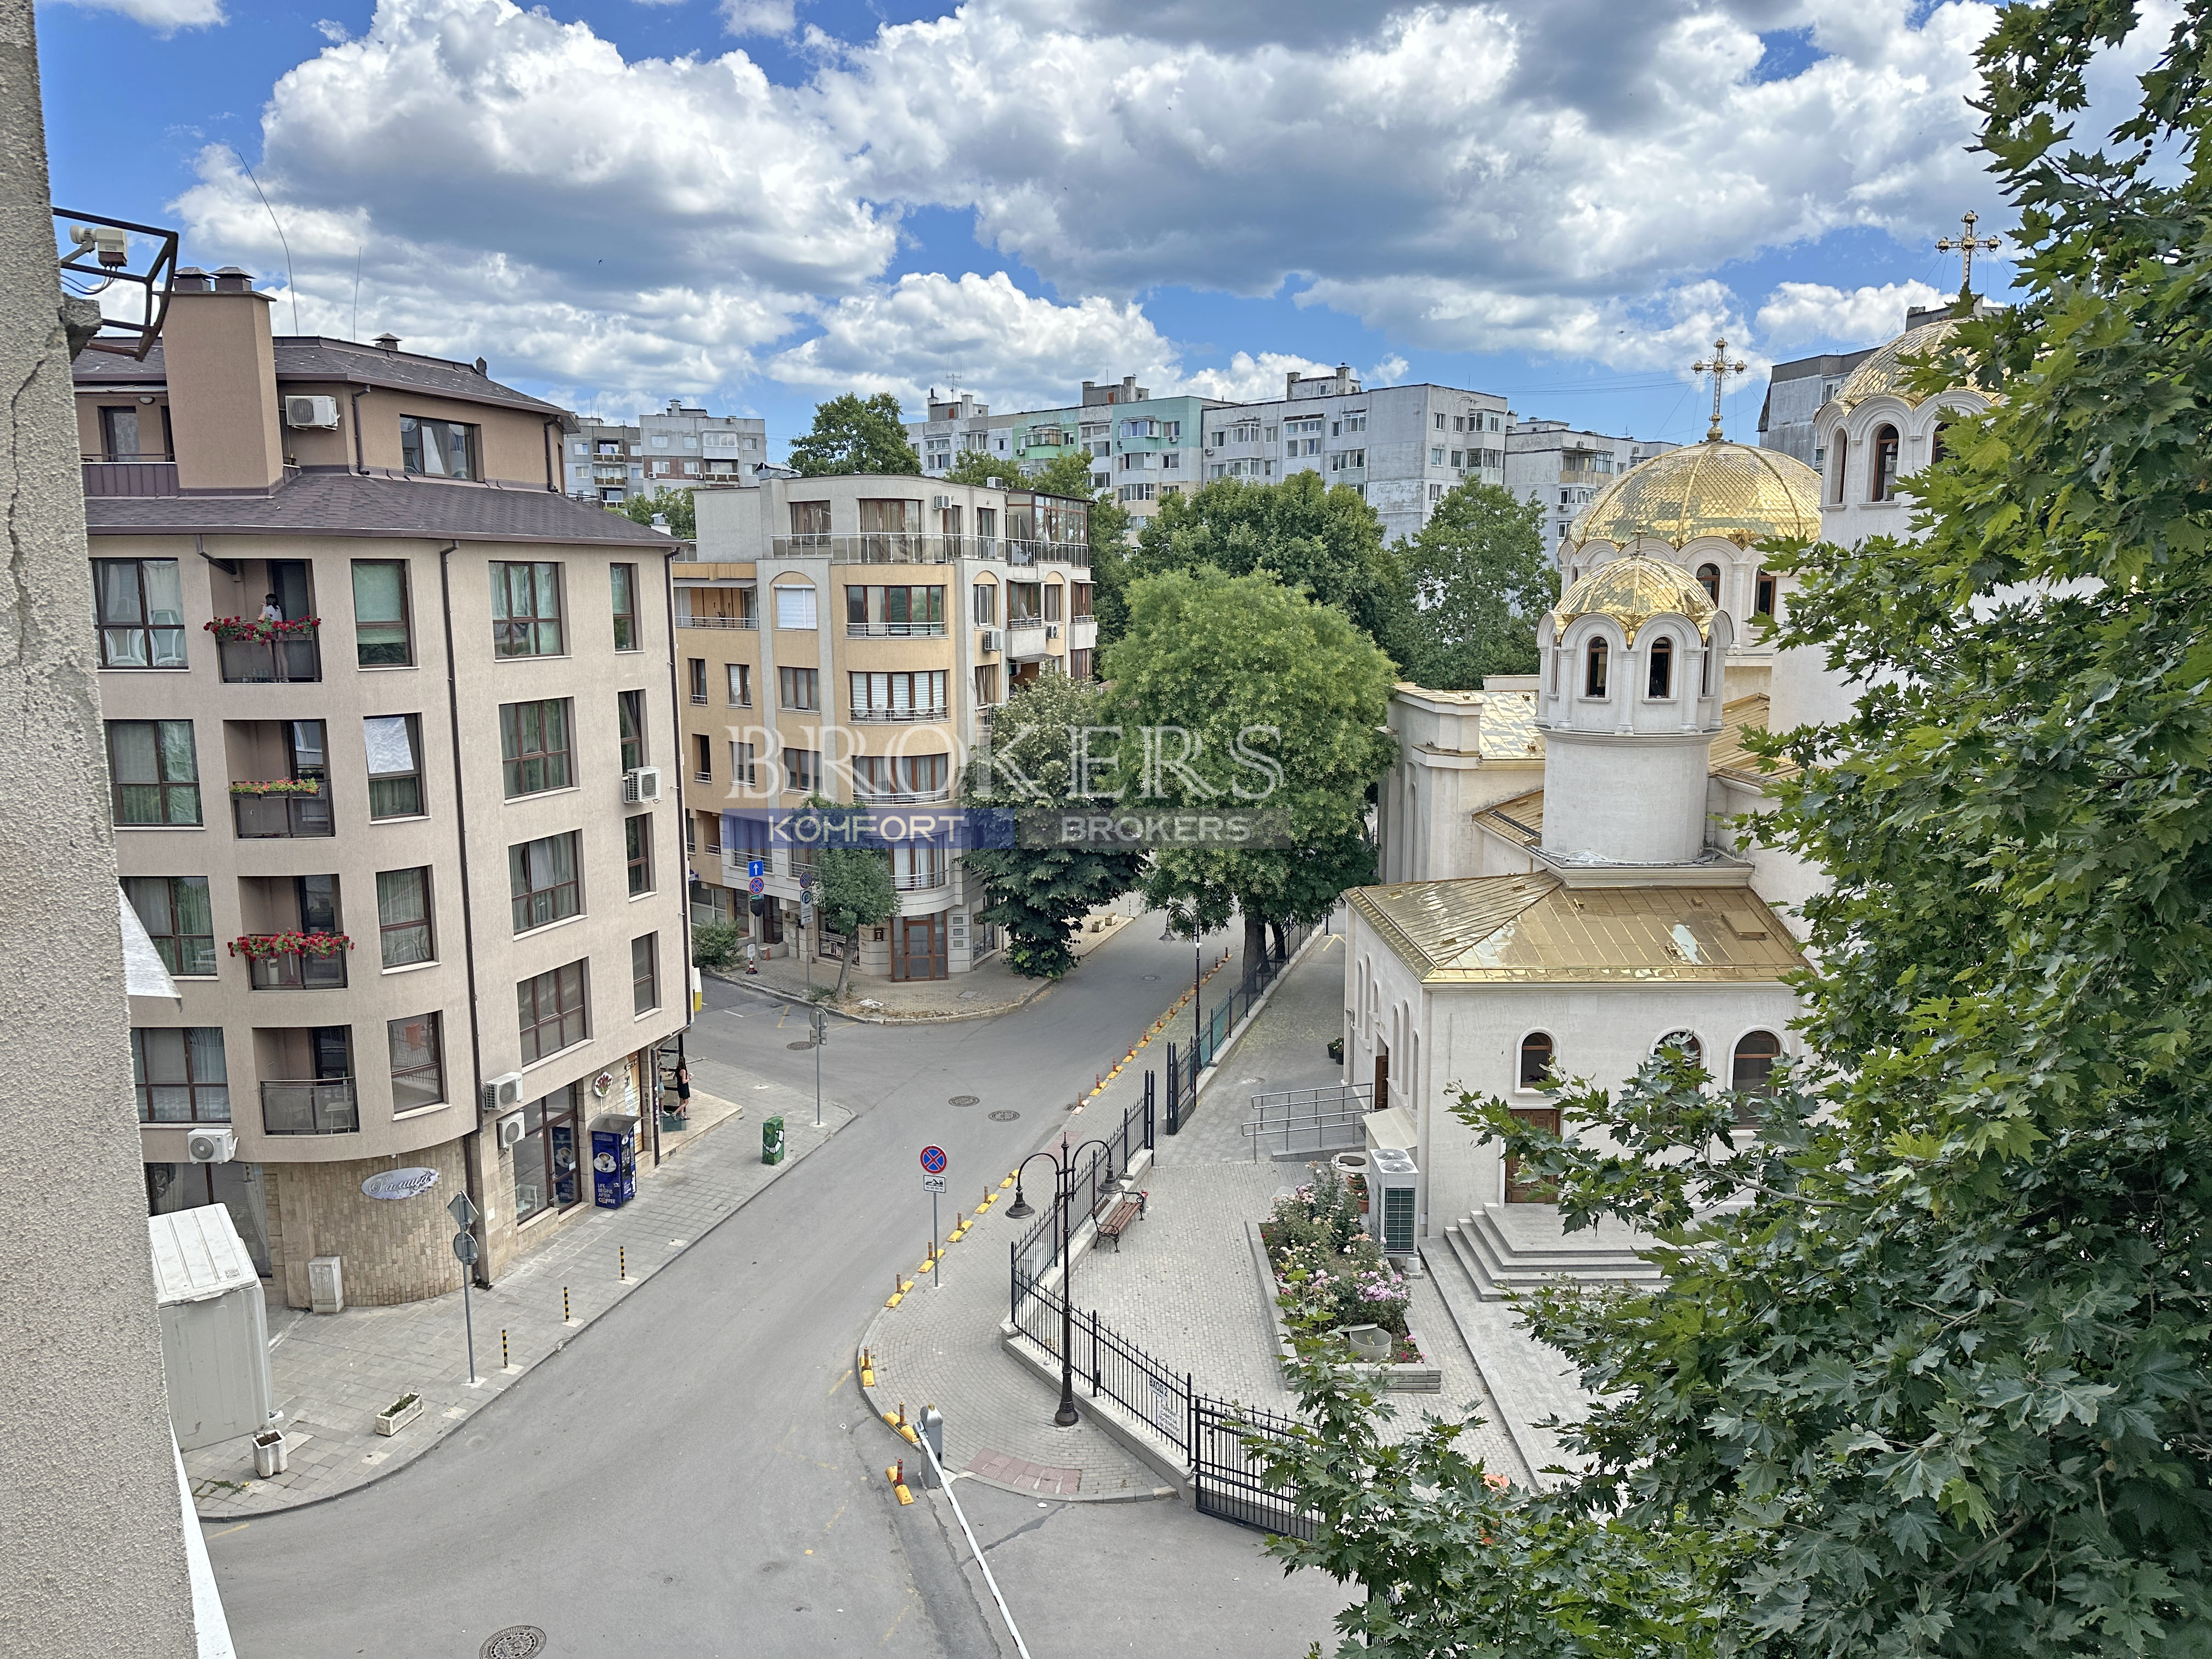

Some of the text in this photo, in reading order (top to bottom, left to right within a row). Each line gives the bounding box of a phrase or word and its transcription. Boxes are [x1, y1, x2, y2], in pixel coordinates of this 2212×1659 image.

[368, 1173, 430, 1196] Ралица
[1149, 1376, 1168, 1397] ВХОД 2
